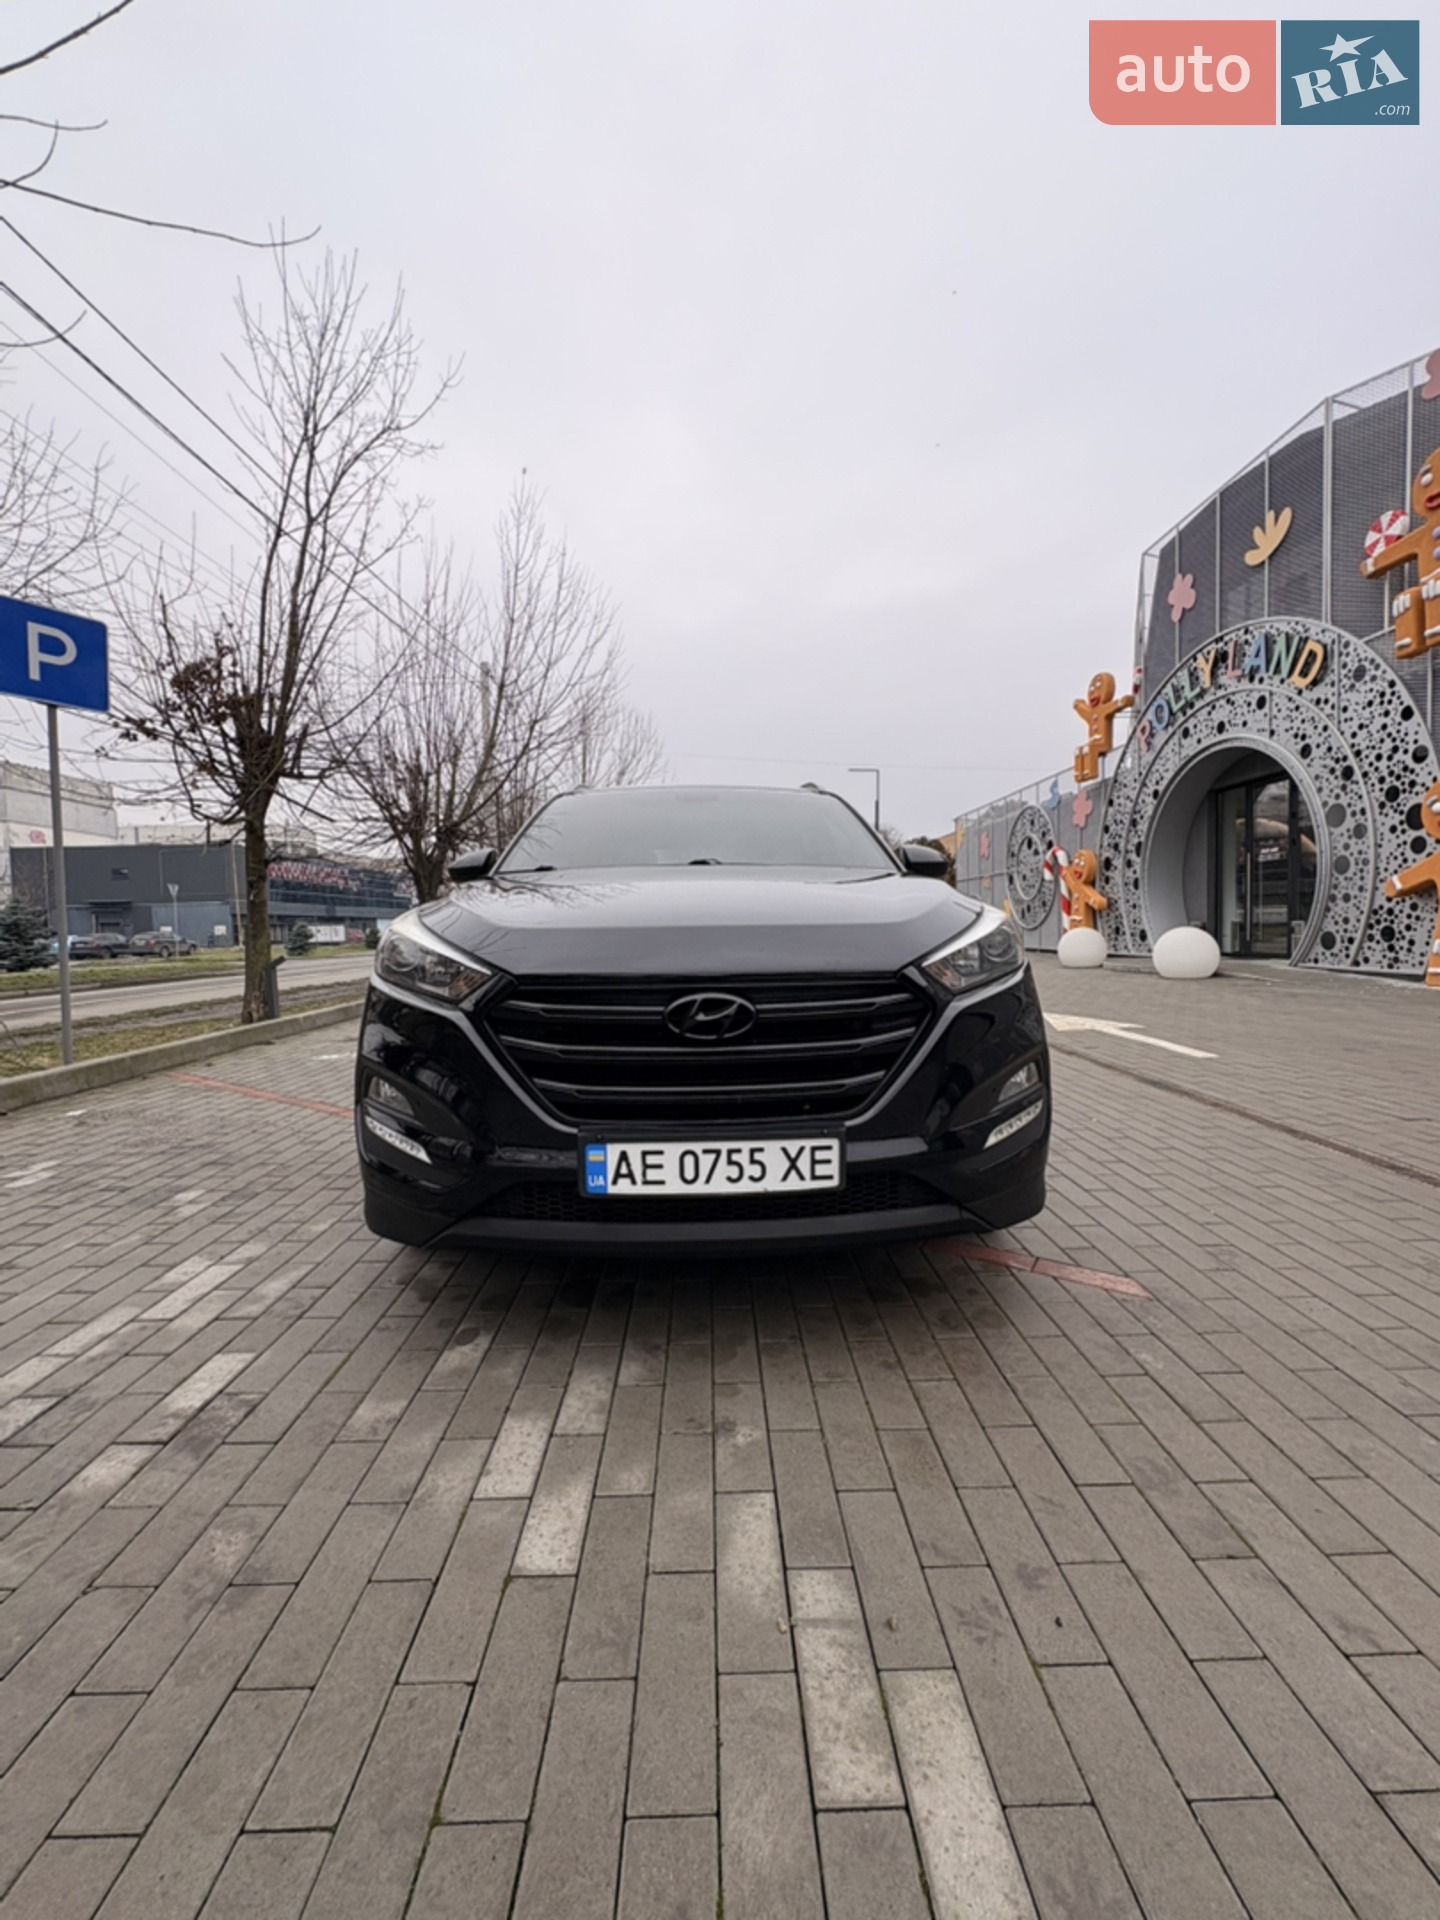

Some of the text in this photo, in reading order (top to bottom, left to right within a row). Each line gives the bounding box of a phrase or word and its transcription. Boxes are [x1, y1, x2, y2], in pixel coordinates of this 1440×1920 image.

[26, 620, 78, 682] P
[588, 1175, 606, 1187] UA
[611, 1144, 835, 1187] AE 0755 XE
